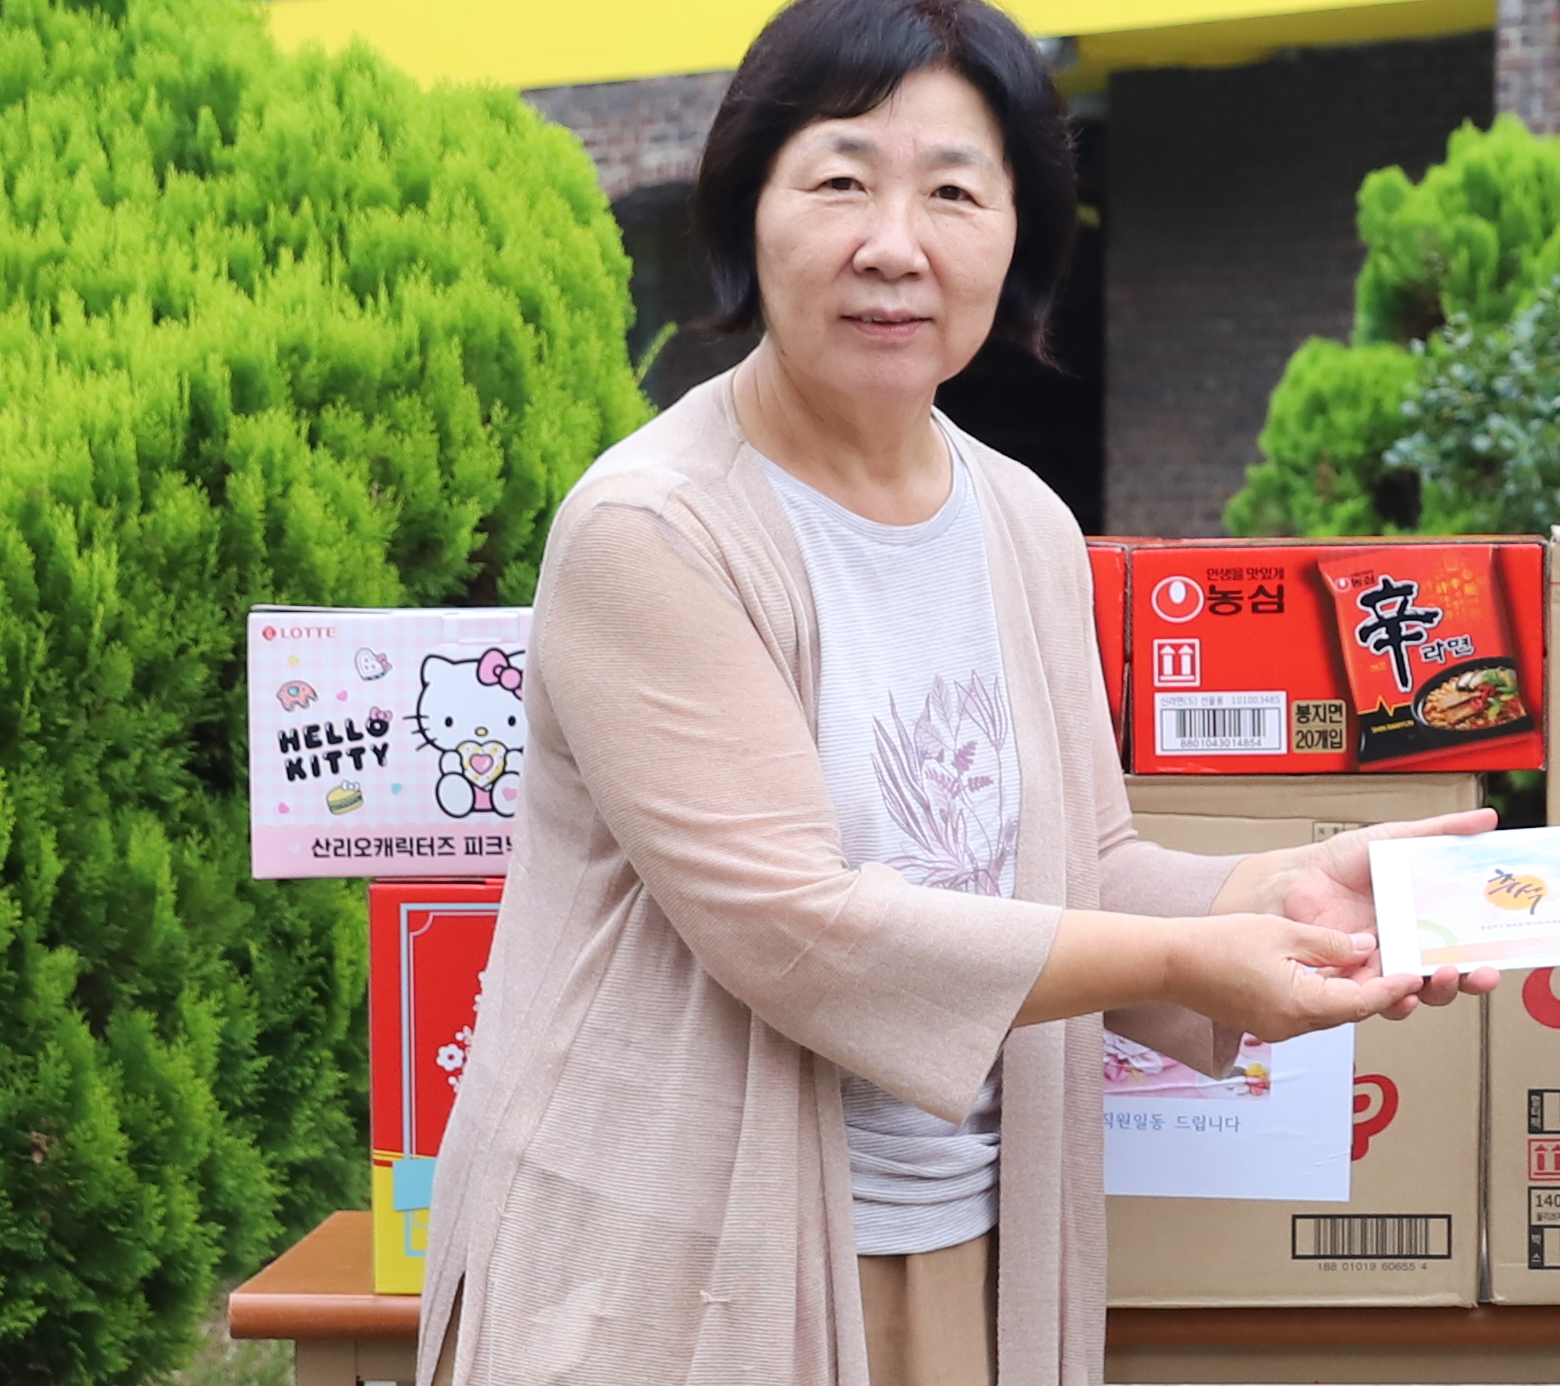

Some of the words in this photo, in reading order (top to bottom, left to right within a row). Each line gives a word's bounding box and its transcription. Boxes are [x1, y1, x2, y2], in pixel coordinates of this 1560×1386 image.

[1206, 567, 1244, 581] 인생을
[1246, 566, 1285, 580] 맛있게
[1207, 584, 1285, 616] 농심
[280, 626, 336, 639] LOTTE
[1357, 576, 1441, 690] 辛
[1421, 635, 1476, 662] 라면
[1295, 703, 1344, 724] 봉지면
[277, 717, 389, 754] HELLO
[1180, 738, 1262, 748] 8801043014854
[1295, 729, 1344, 750] 20개입
[286, 743, 389, 782] KITTY
[311, 836, 456, 858] 산리오캐릭터즈
[1488, 868, 1543, 915] 추석
[1176, 1114, 1242, 1133] 드립니다
[1342, 1262, 1376, 1271] 01019
